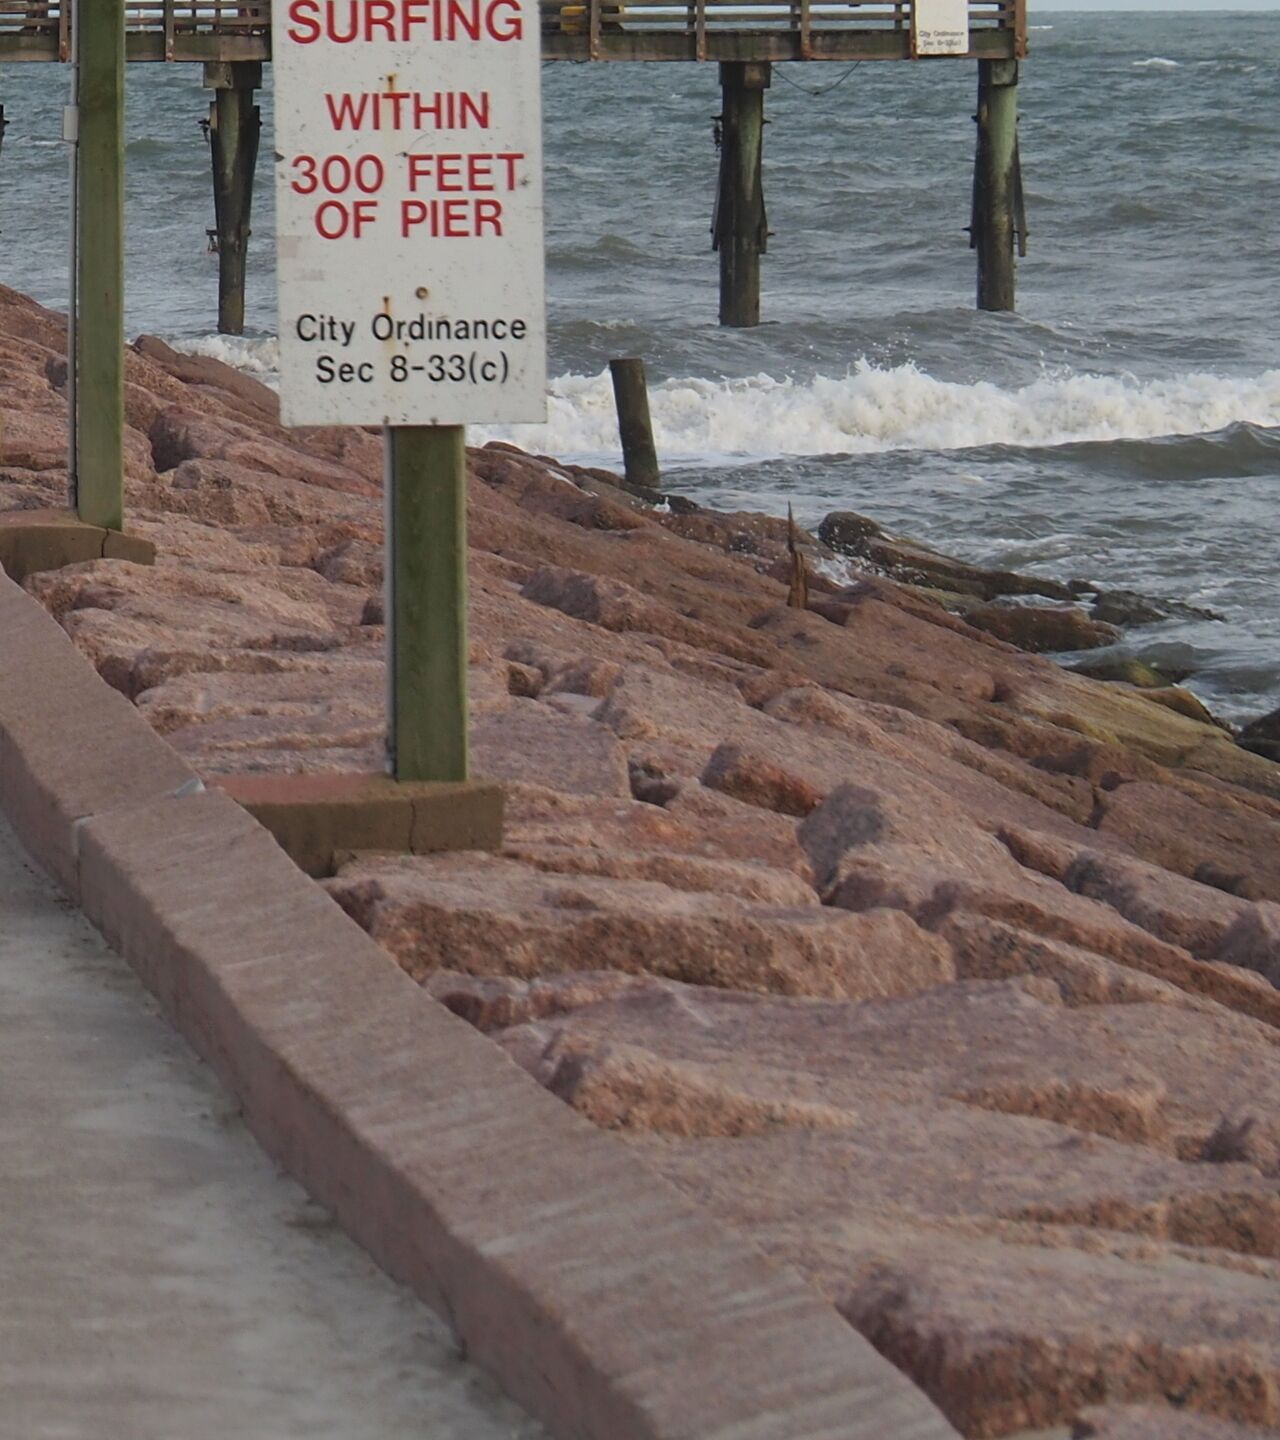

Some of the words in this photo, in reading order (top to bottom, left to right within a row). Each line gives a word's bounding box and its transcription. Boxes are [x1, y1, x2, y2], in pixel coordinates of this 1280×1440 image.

[326, 91, 490, 131] WITHIN
[290, 154, 384, 195] 300
[409, 153, 524, 192] FEET
[315, 200, 378, 240] OF
[401, 199, 503, 238] PIER
[296, 313, 356, 347] City
[371, 313, 527, 341] Ordinance
[316, 357, 374, 384] Sec
[390, 350, 510, 384] 8-33(c)
